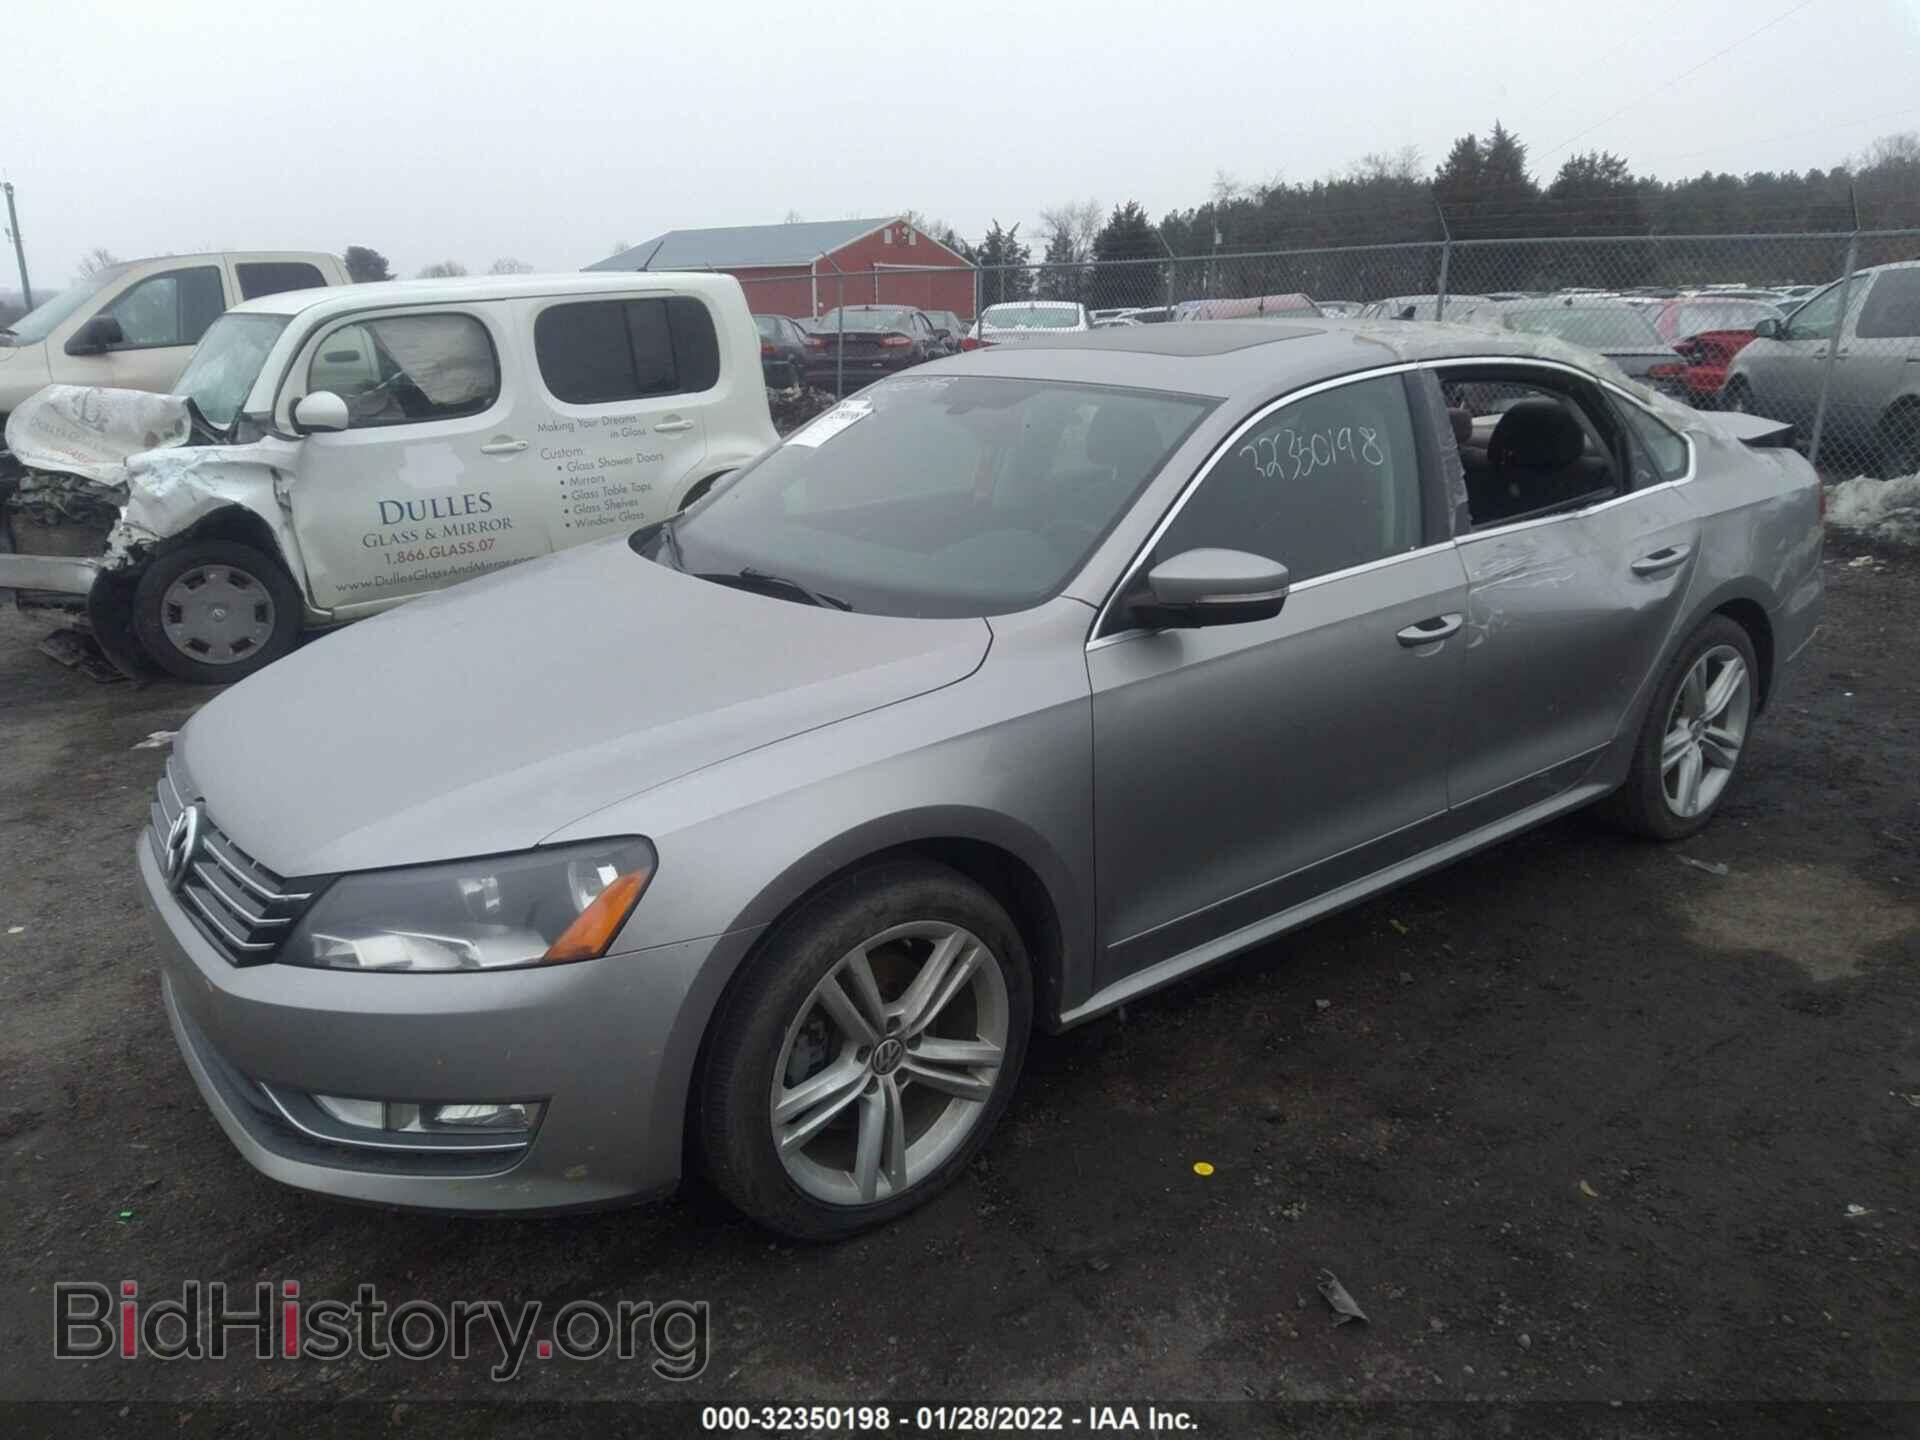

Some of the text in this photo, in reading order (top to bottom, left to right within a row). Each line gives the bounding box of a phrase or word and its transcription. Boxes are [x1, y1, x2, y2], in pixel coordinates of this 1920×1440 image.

[537, 415, 637, 433] Making Your Dreams
[609, 425, 647, 440] in Glass
[540, 447, 583, 460] Custom
[566, 451, 664, 472] Glass Shower Doors
[1239, 426, 1384, 481] 32350198
[569, 474, 605, 487] Mirrors
[571, 488, 599, 501] Glass
[602, 485, 627, 497] Table
[573, 498, 638, 514] Glass Shelves
[574, 510, 645, 528] Window Glass
[424, 527, 437, 540] &
[384, 537, 496, 565] 1.866.GLASS.07
